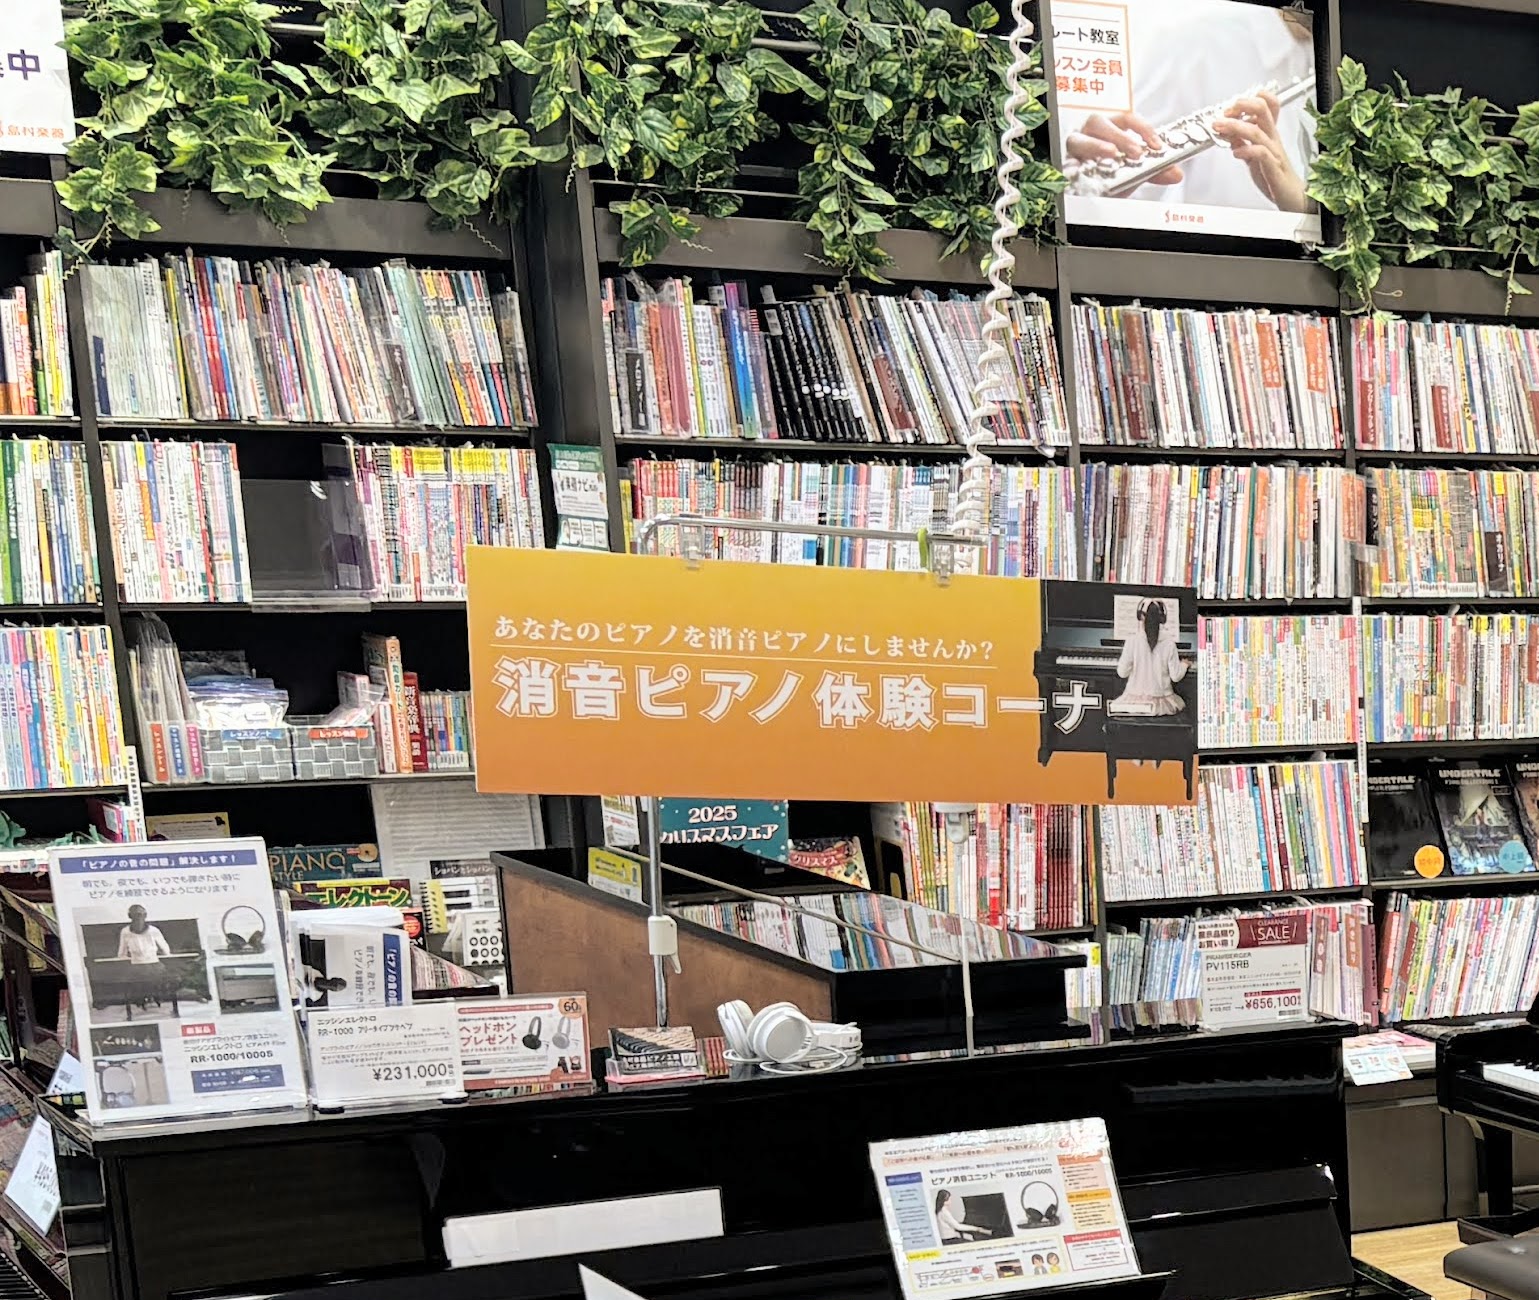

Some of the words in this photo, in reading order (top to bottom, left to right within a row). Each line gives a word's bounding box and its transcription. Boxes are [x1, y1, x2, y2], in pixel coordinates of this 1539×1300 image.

[0, 49, 41, 80] 中
[494, 614, 995, 662] あなたのピアノを消音ピアノにしませんか？
[495, 655, 1156, 736] 消音ピアノ体験コーナー
[688, 805, 738, 823] 2025
[269, 852, 345, 872] PIANO
[1257, 926, 1290, 940] SALE
[1206, 960, 1250, 972] PV115RB
[317, 1016, 377, 1026] ニッシンエレクトロ
[459, 1021, 517, 1034] ヘッドホン
[460, 1033, 518, 1047] プレゼント
[372, 1063, 447, 1081] ¥231,000
